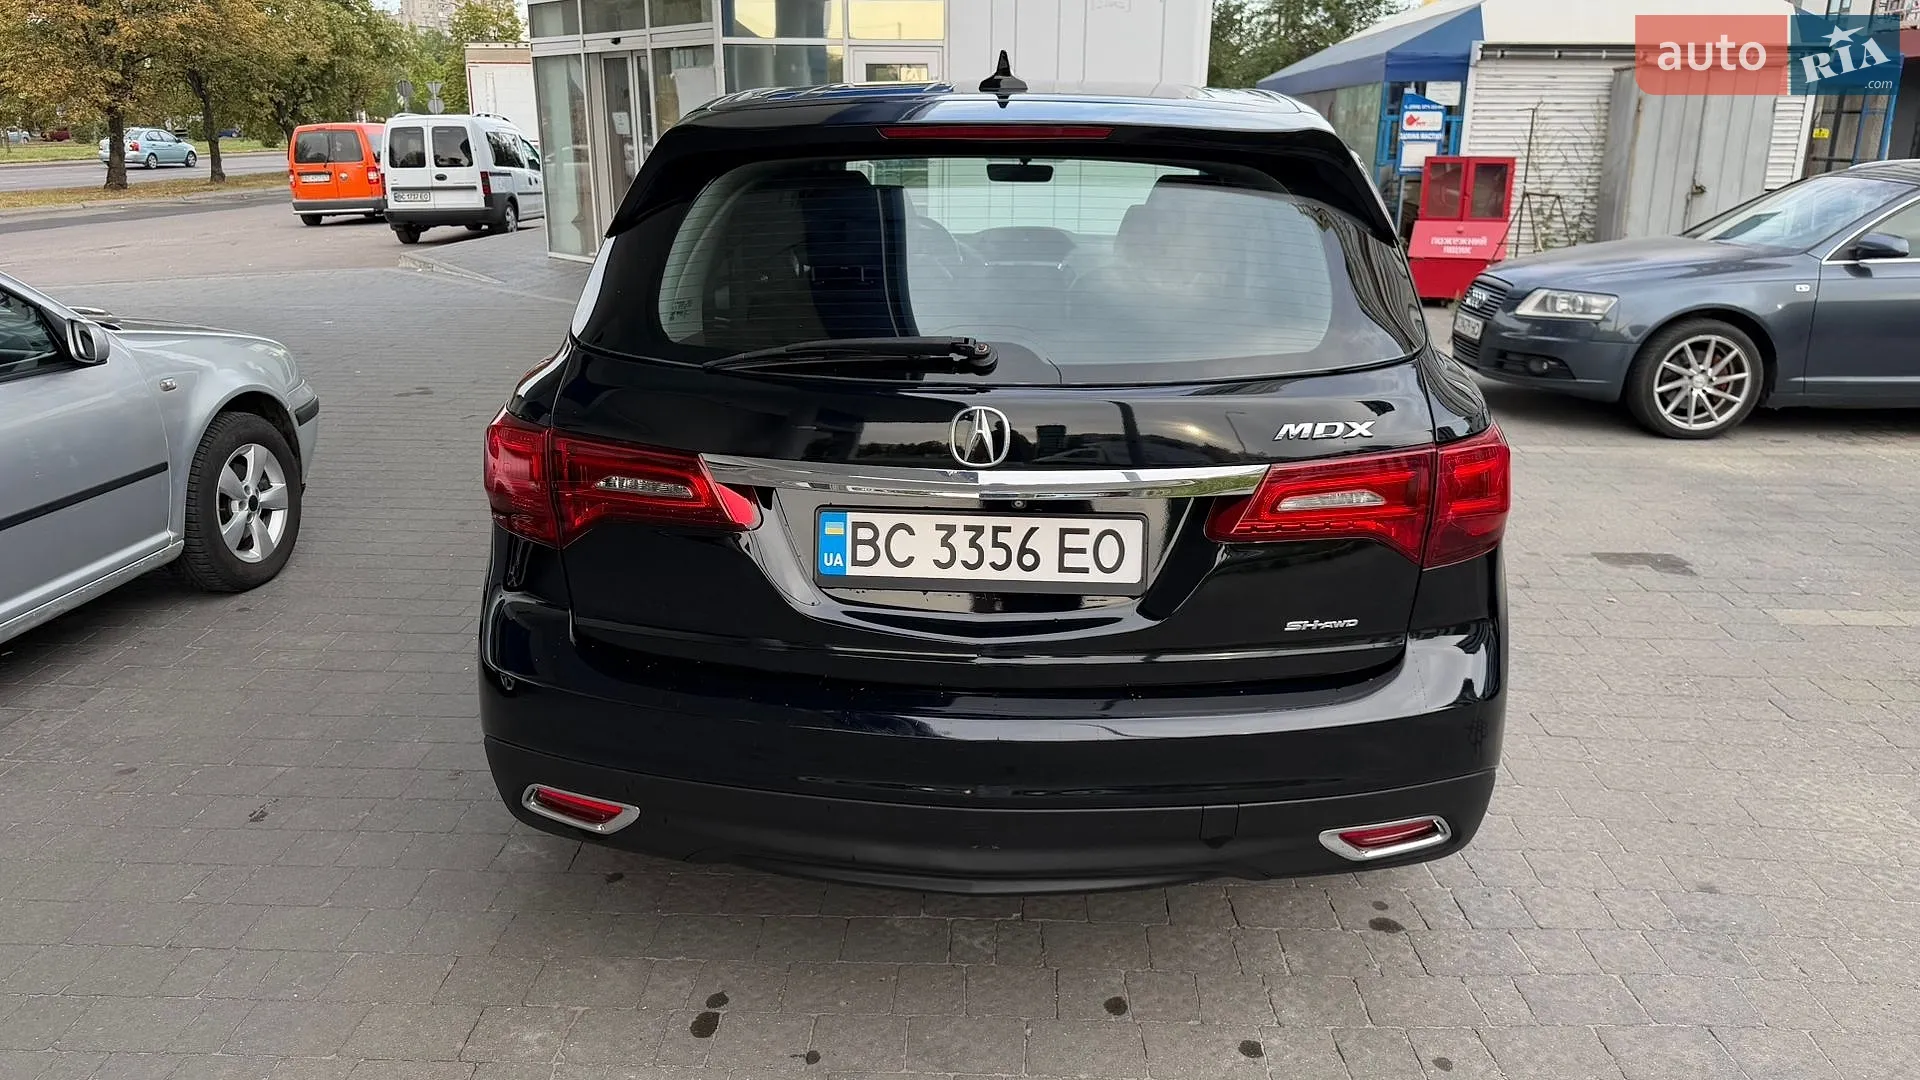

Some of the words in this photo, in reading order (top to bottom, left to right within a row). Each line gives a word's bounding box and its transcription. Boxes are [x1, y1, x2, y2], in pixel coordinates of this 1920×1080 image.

[1274, 420, 1376, 441] MDX
[850, 521, 916, 569] BC
[932, 523, 1041, 573] 3356
[1057, 527, 1126, 575] EO
[823, 552, 844, 567] UA
[1284, 619, 1359, 632] SH-AWD
